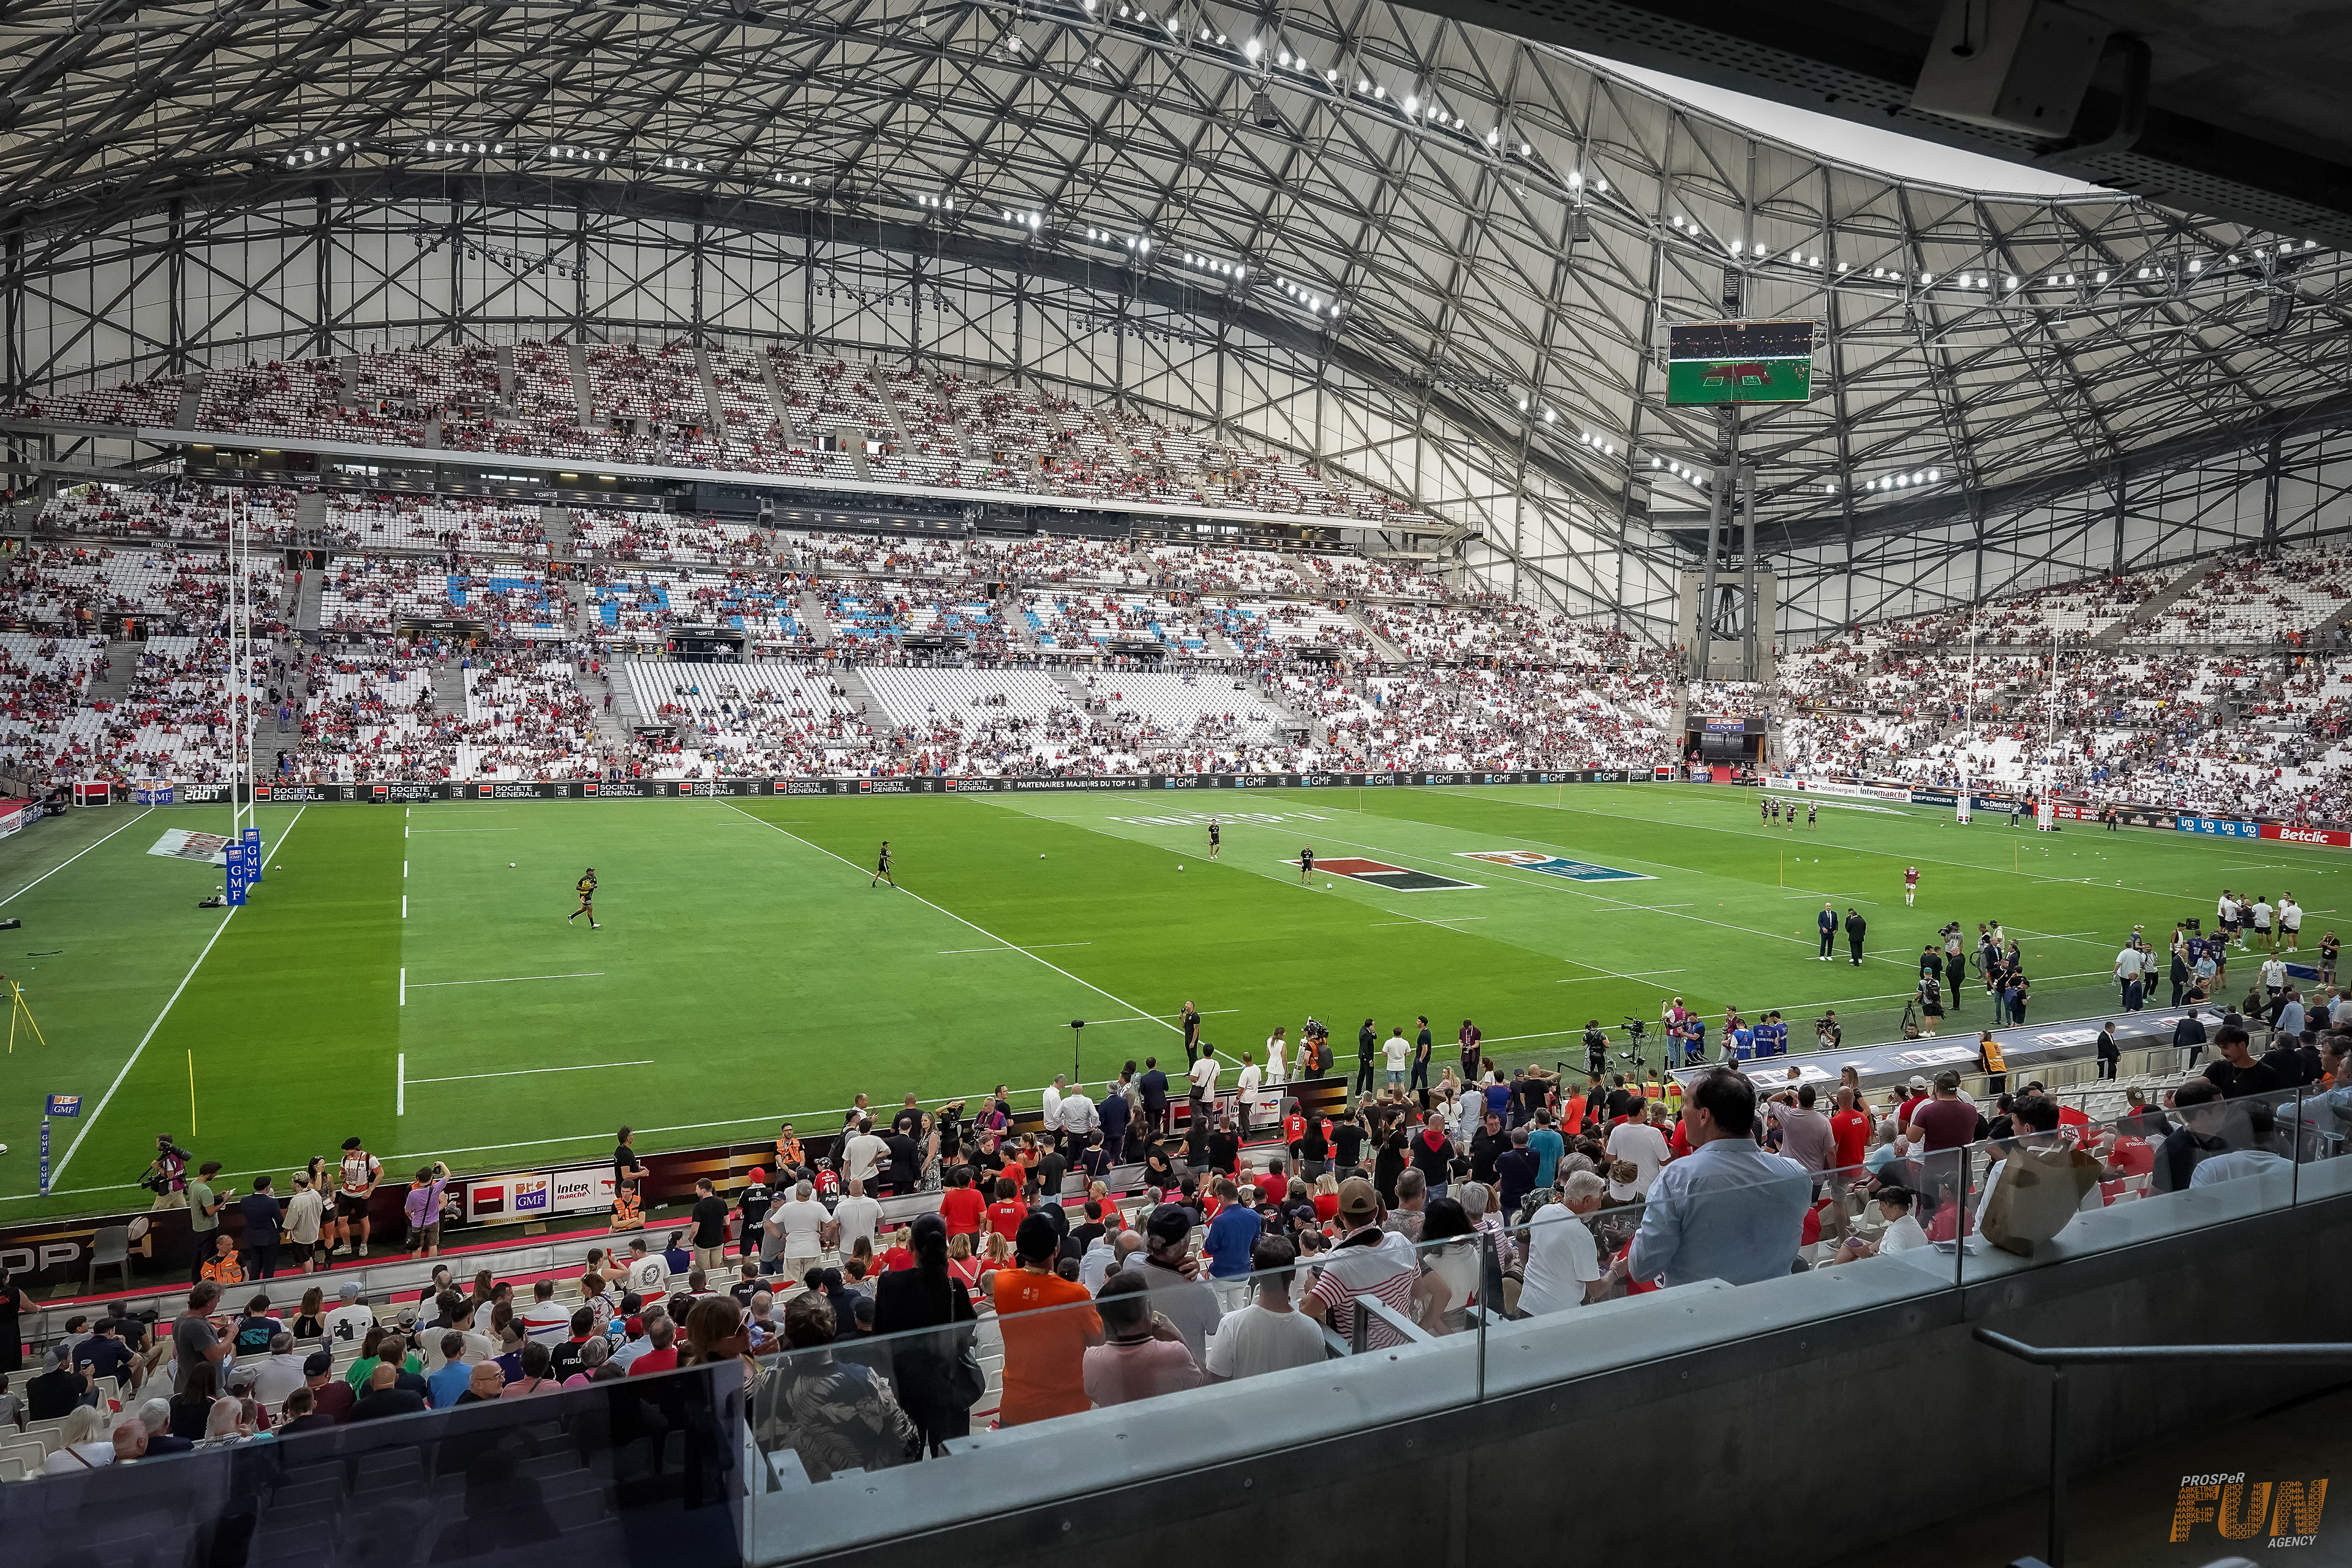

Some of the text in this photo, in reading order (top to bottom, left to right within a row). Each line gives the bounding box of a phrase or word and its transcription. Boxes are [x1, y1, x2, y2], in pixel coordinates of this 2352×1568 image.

[1177, 778, 1197, 786] GMF
[1246, 777, 1266, 786] GMF
[1311, 776, 1331, 785] GMF
[1436, 775, 1453, 783] GMF
[1820, 785, 1855, 794] TotalEnergies
[1860, 787, 1907, 799] Intermarché
[148, 792, 172, 801] GMF
[184, 790, 219, 800] 20:07
[2280, 828, 2329, 843] Betclic
[247, 846, 257, 878] GMF
[231, 865, 242, 900] GMF
[1292, 1121, 1300, 1131] 12
[1852, 1117, 1863, 1125] CROS
[557, 1183, 590, 1195] Inter
[823, 1182, 837, 1194] 10
[557, 1191, 587, 1200] marché
[518, 1196, 544, 1207] GMF
